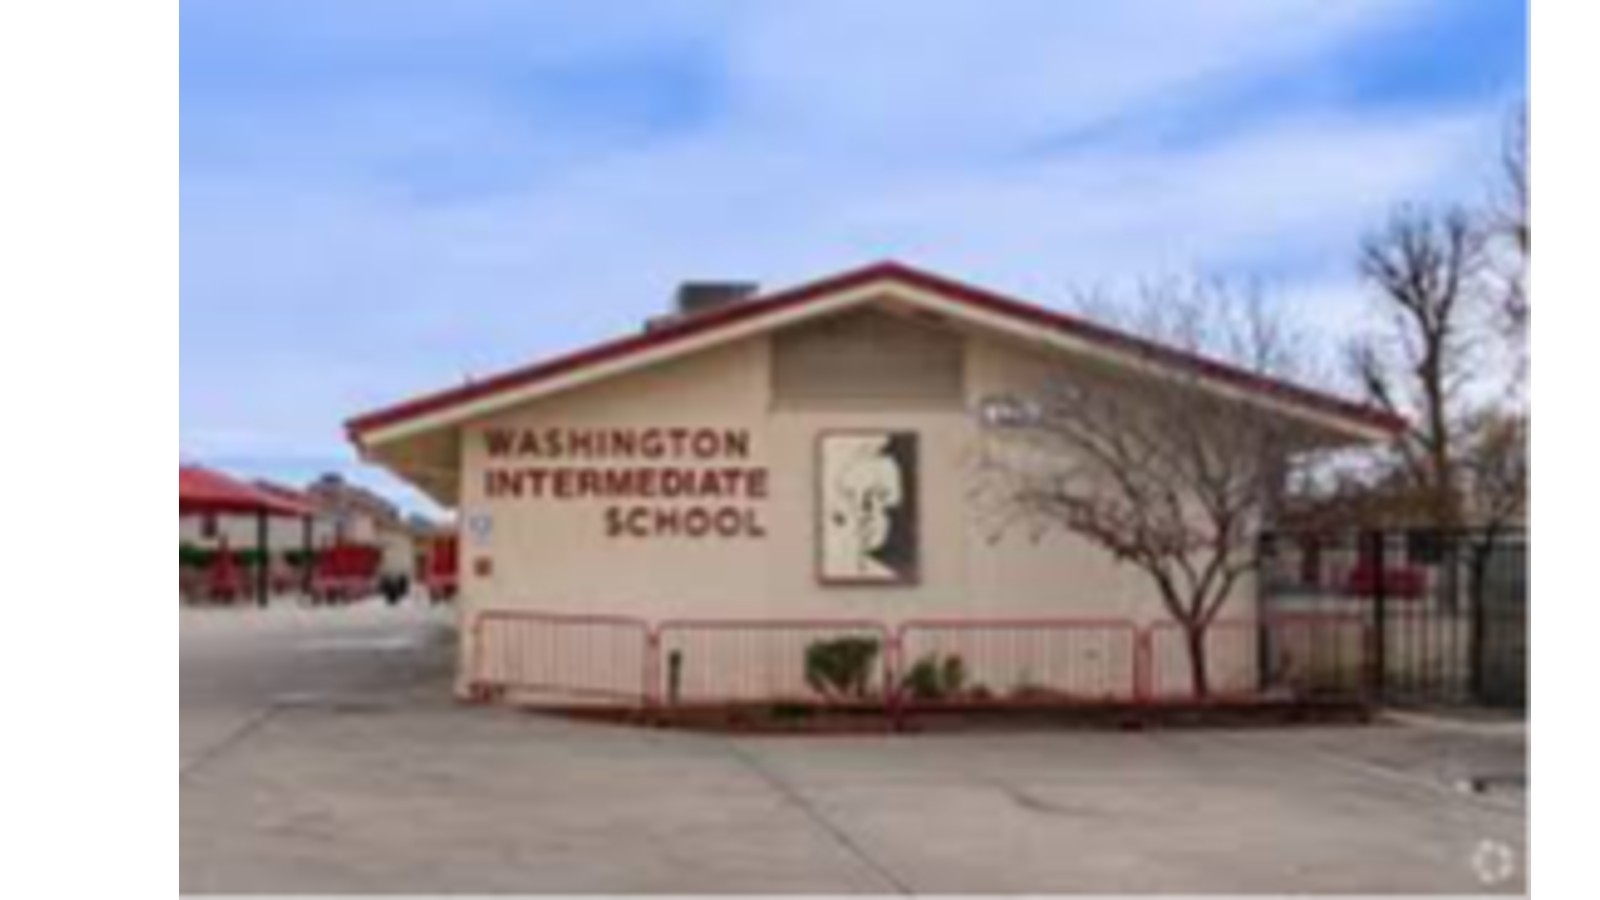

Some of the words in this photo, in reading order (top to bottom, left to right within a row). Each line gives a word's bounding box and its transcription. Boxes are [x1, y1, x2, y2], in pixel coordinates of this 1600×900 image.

[485, 427, 750, 458] WASHINGTON
[484, 467, 769, 498] INTERMEDIATE
[604, 506, 766, 538] SCHOOL
